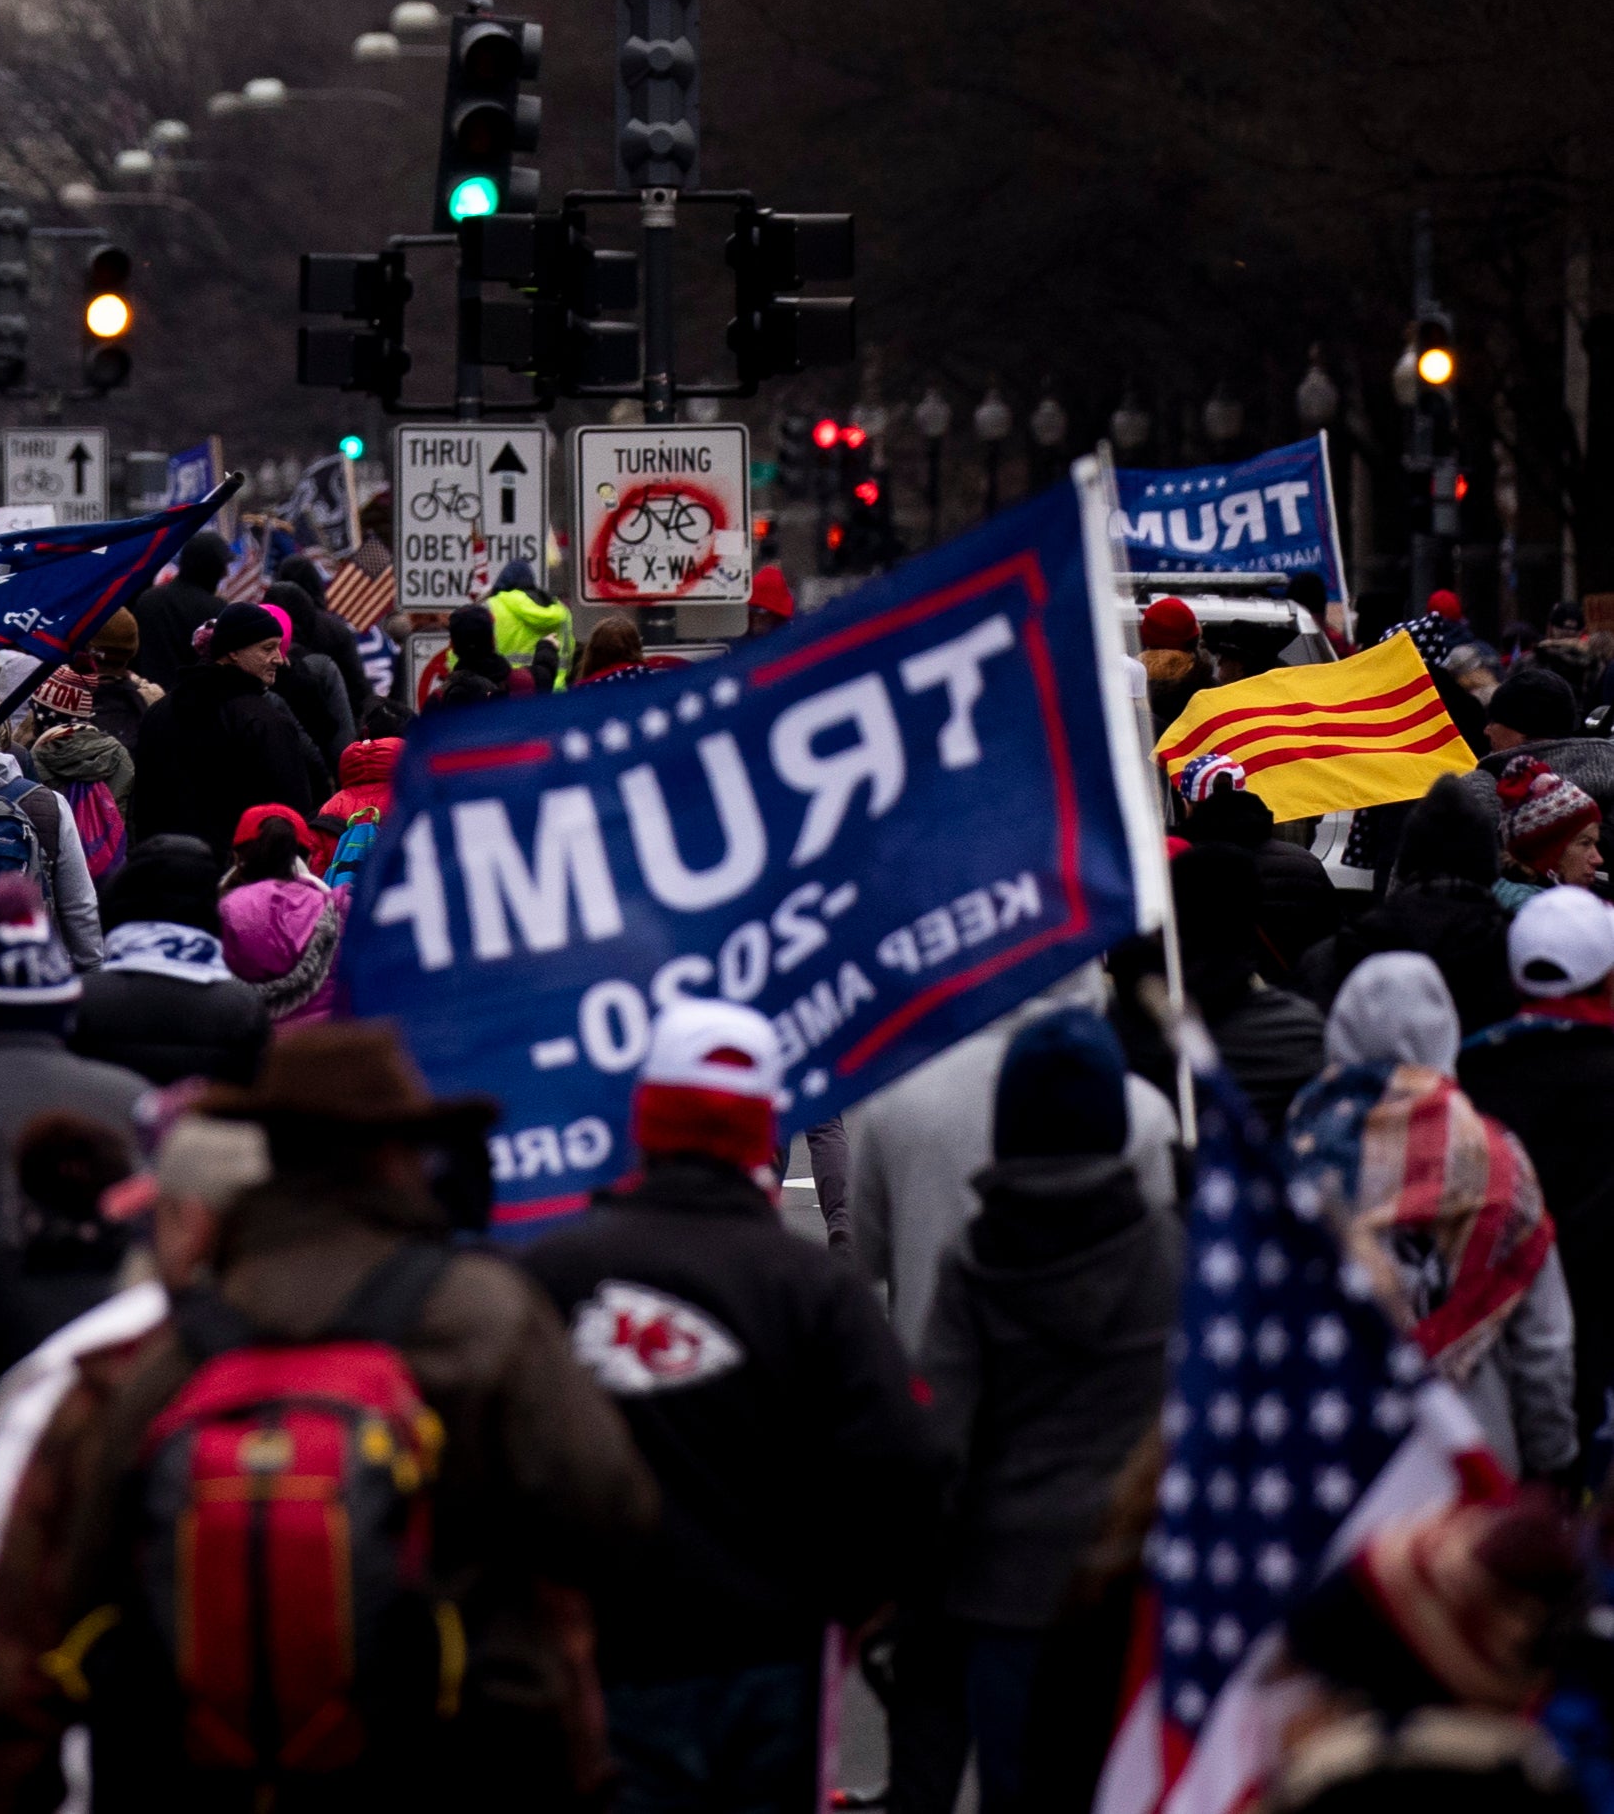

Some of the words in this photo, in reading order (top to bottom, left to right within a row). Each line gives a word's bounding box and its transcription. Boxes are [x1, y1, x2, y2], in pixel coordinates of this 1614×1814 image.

[11, 439, 57, 458] THRU
[408, 438, 474, 467] THRU
[614, 446, 712, 474] TURNING
[406, 535, 476, 562] OBEY
[484, 535, 537, 562] THIS
[588, 556, 630, 583] USE
[406, 569, 477, 598] SIGN
